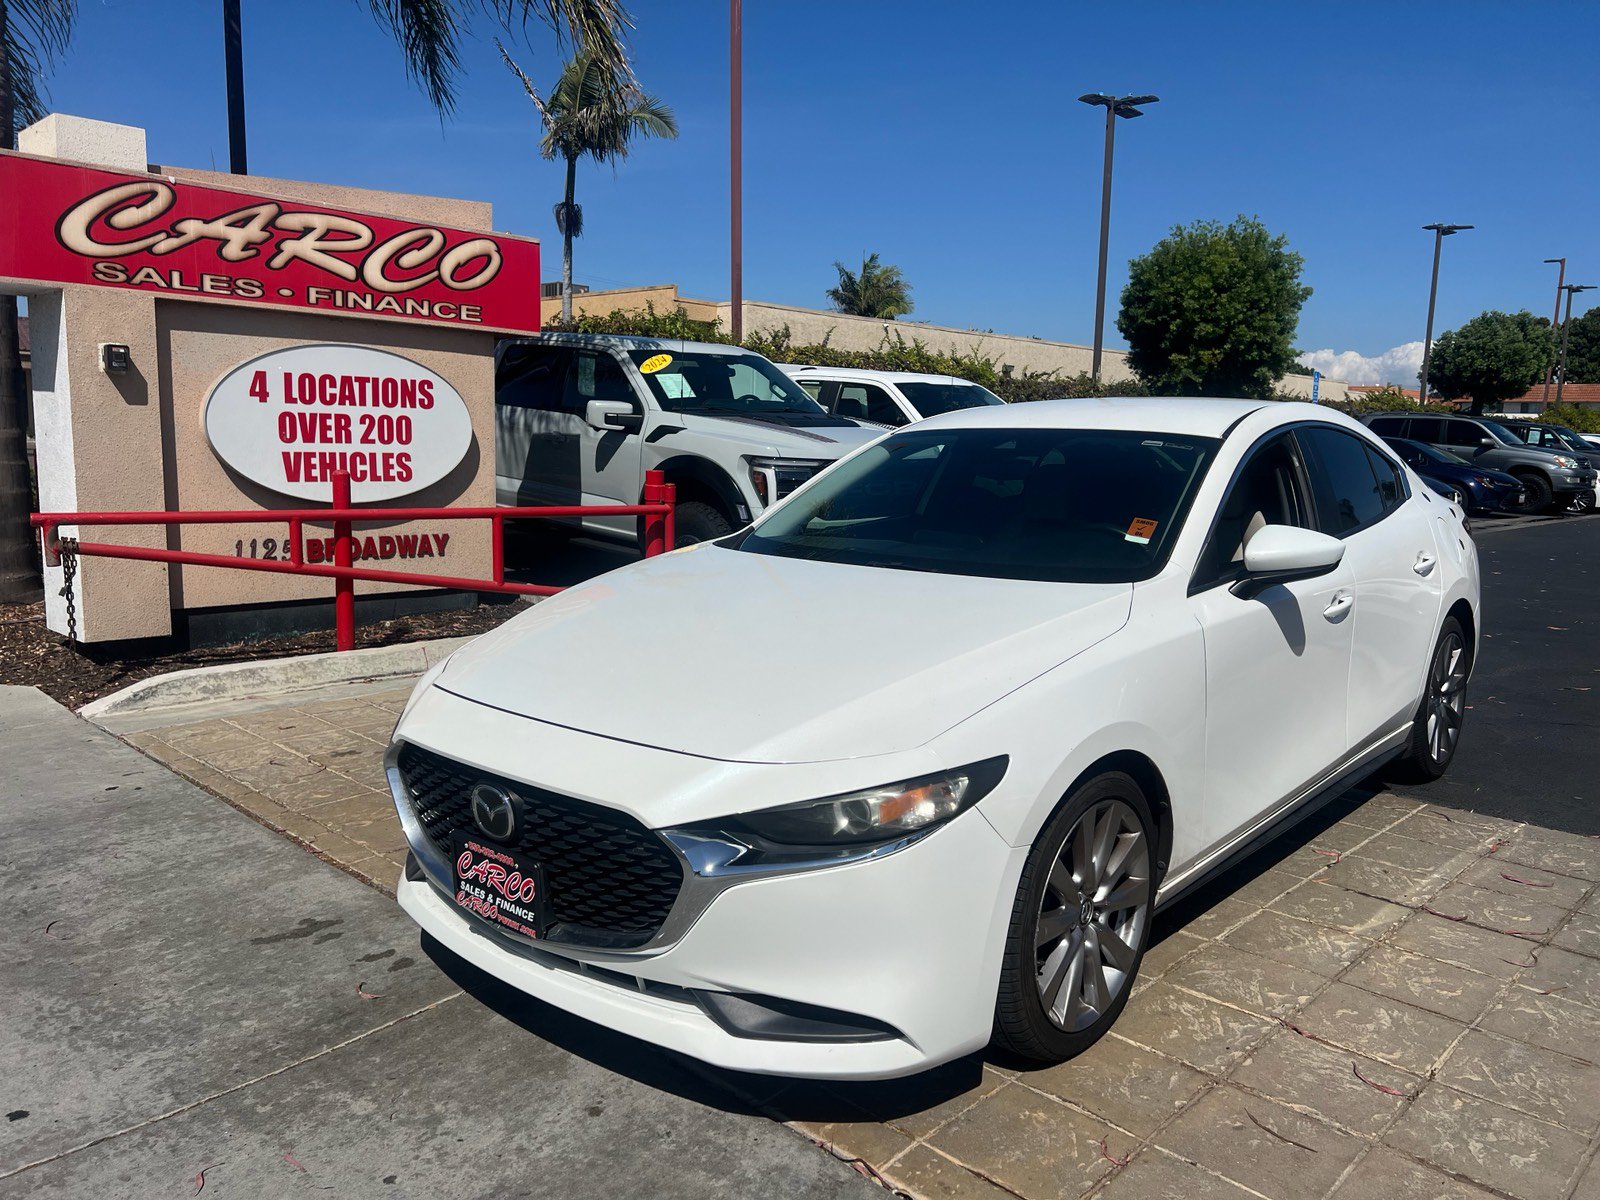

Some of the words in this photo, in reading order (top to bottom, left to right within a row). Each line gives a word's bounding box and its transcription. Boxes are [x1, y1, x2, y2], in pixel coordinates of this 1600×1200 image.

[55, 180, 504, 294] CARCO
[92, 261, 265, 299] SALES
[306, 286, 483, 323] FINANCE
[644, 355, 667, 371] 2024
[249, 370, 269, 403] 4
[283, 372, 434, 409] LOCATIONS
[278, 411, 352, 444] OVER
[360, 414, 413, 445] 200
[281, 451, 413, 483] VEHICLES
[457, 851, 535, 903] CARCO
[455, 890, 498, 919] CARCO
[460, 881, 486, 899] SALES
[487, 893, 494, 904] &
[495, 898, 535, 922] FINANCE
